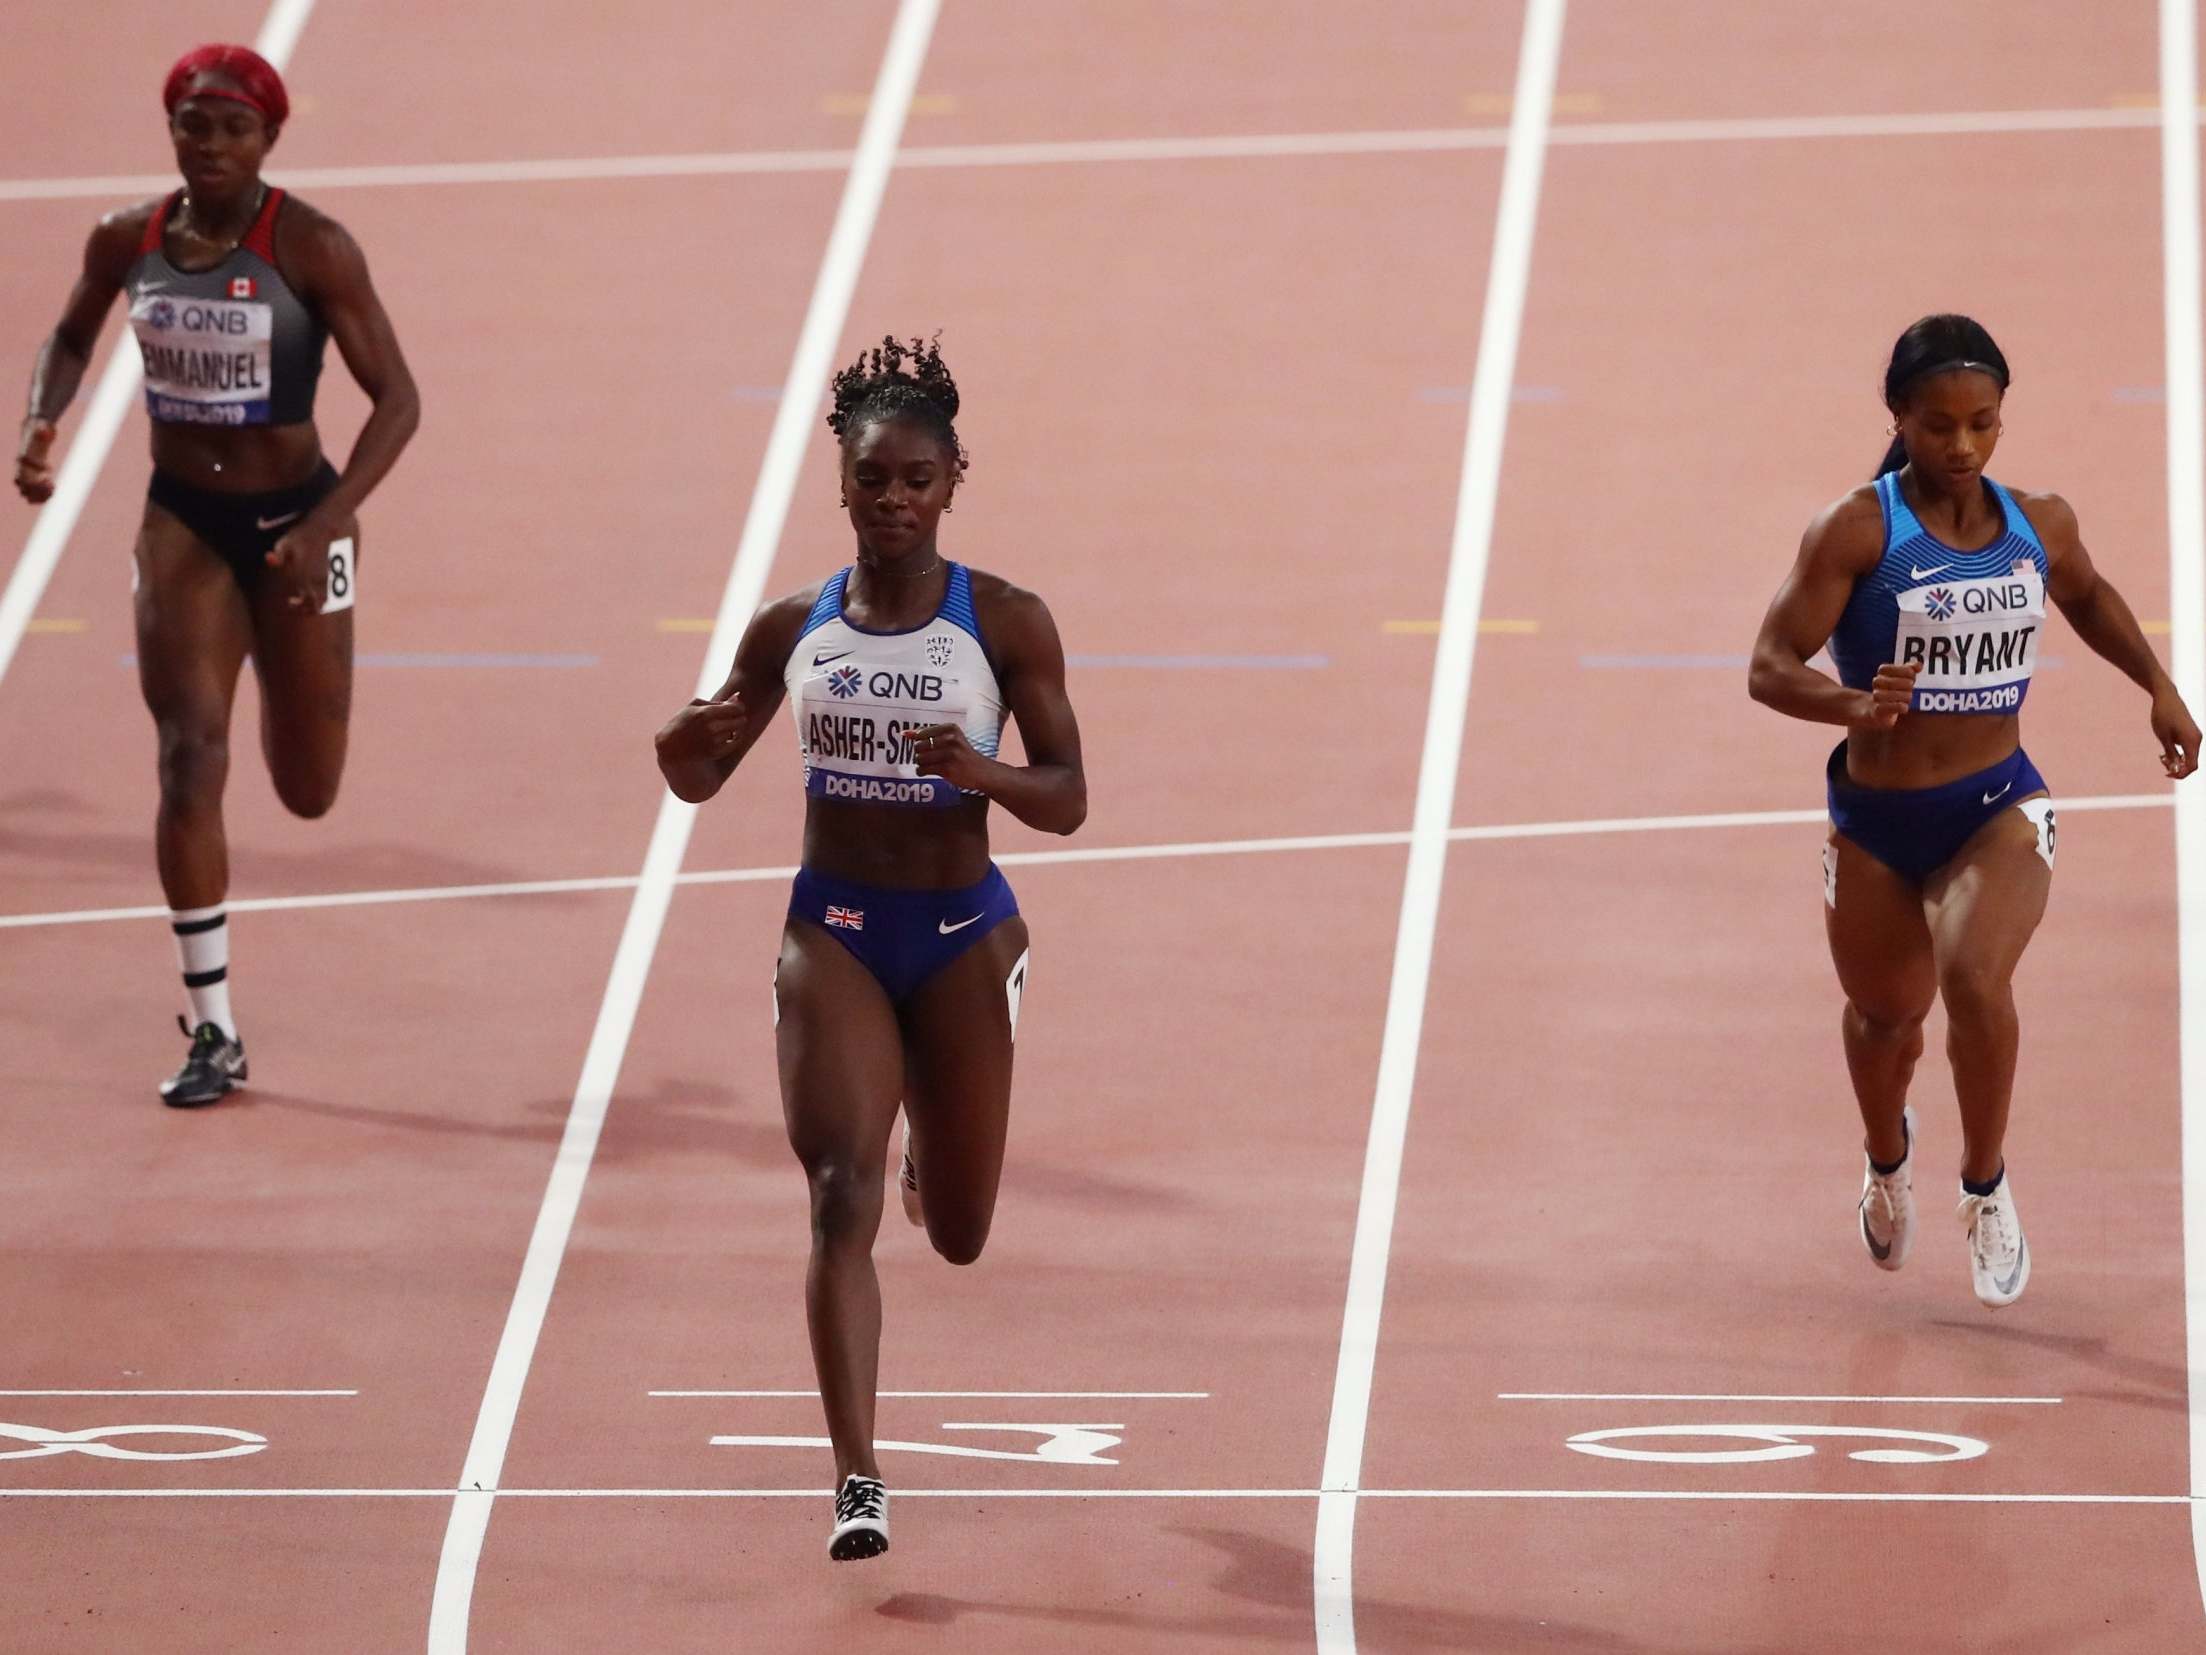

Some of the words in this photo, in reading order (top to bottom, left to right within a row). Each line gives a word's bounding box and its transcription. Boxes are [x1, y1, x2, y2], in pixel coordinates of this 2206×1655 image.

[182, 306, 248, 336] QNB
[331, 555, 348, 598] 8
[1963, 583, 2028, 614] QNB
[1903, 626, 2036, 676] BRYANT
[869, 671, 943, 701] QNB
[1919, 686, 2019, 712] DOHA2019
[825, 775, 935, 803] DOHA2019
[1566, 1424, 1990, 1464] 6
